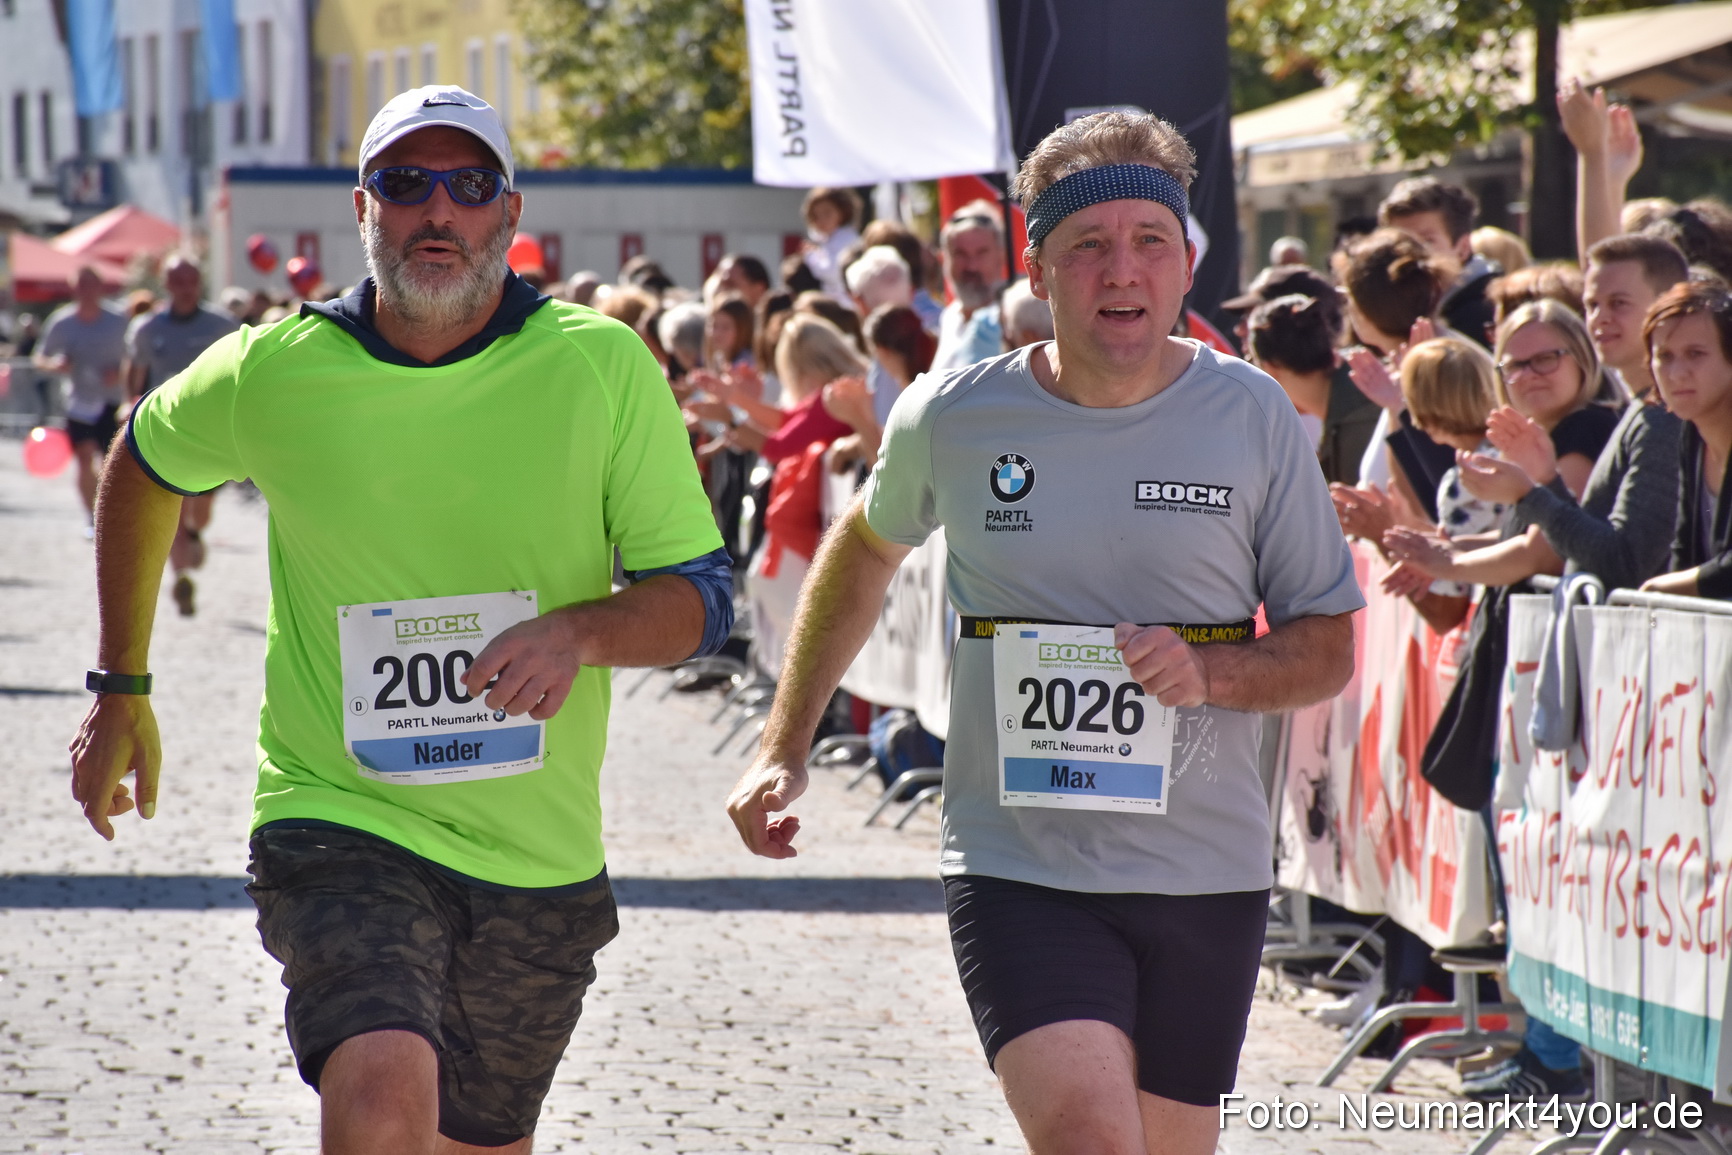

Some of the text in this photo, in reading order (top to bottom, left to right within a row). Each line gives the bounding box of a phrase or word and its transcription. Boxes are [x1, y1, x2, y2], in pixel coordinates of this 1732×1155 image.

[994, 454, 1032, 471] BMW
[1135, 481, 1233, 509] BOCK
[985, 510, 1033, 522] PARTL
[1134, 503, 1231, 517] inspired by smart concepts
[985, 523, 1033, 532] Neumarkt
[395, 613, 482, 638] BOCK
[396, 637, 423, 646] inspired
[454, 633, 484, 641] concepts
[1039, 643, 1122, 665] BOCK
[373, 649, 505, 711] 200
[355, 701, 363, 712] D
[1018, 677, 1146, 736] 2026
[387, 717, 429, 730] PARTL
[431, 713, 489, 727] Neumarkt
[413, 739, 484, 765] Nader
[1031, 740, 1059, 751] PARTL
[1060, 741, 1115, 755] Neumarkt
[1175, 734, 1202, 778] September
[1201, 716, 1214, 737] 2018
[1050, 765, 1097, 789] Max
